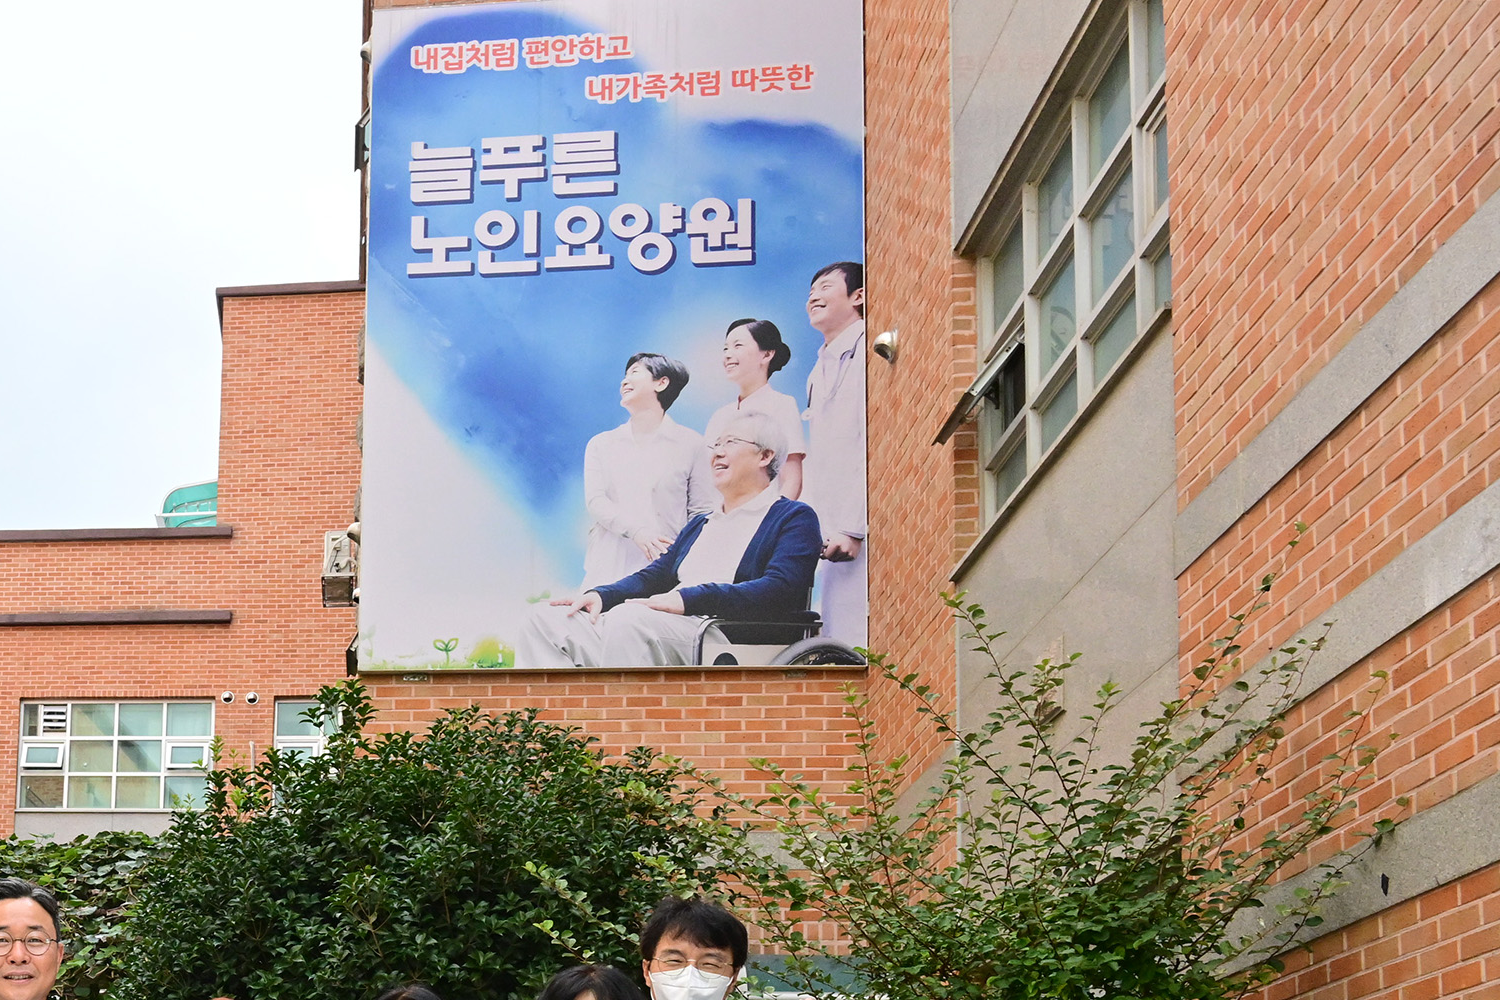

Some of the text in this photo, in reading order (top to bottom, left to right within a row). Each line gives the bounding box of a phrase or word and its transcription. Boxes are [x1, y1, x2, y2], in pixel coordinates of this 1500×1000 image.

[414, 35, 631, 71] 내집처럼 편안하고
[588, 64, 814, 101] 내가족처럼 따뜻한
[408, 130, 621, 204] 늘푸른
[406, 197, 756, 278] 노인요양원
